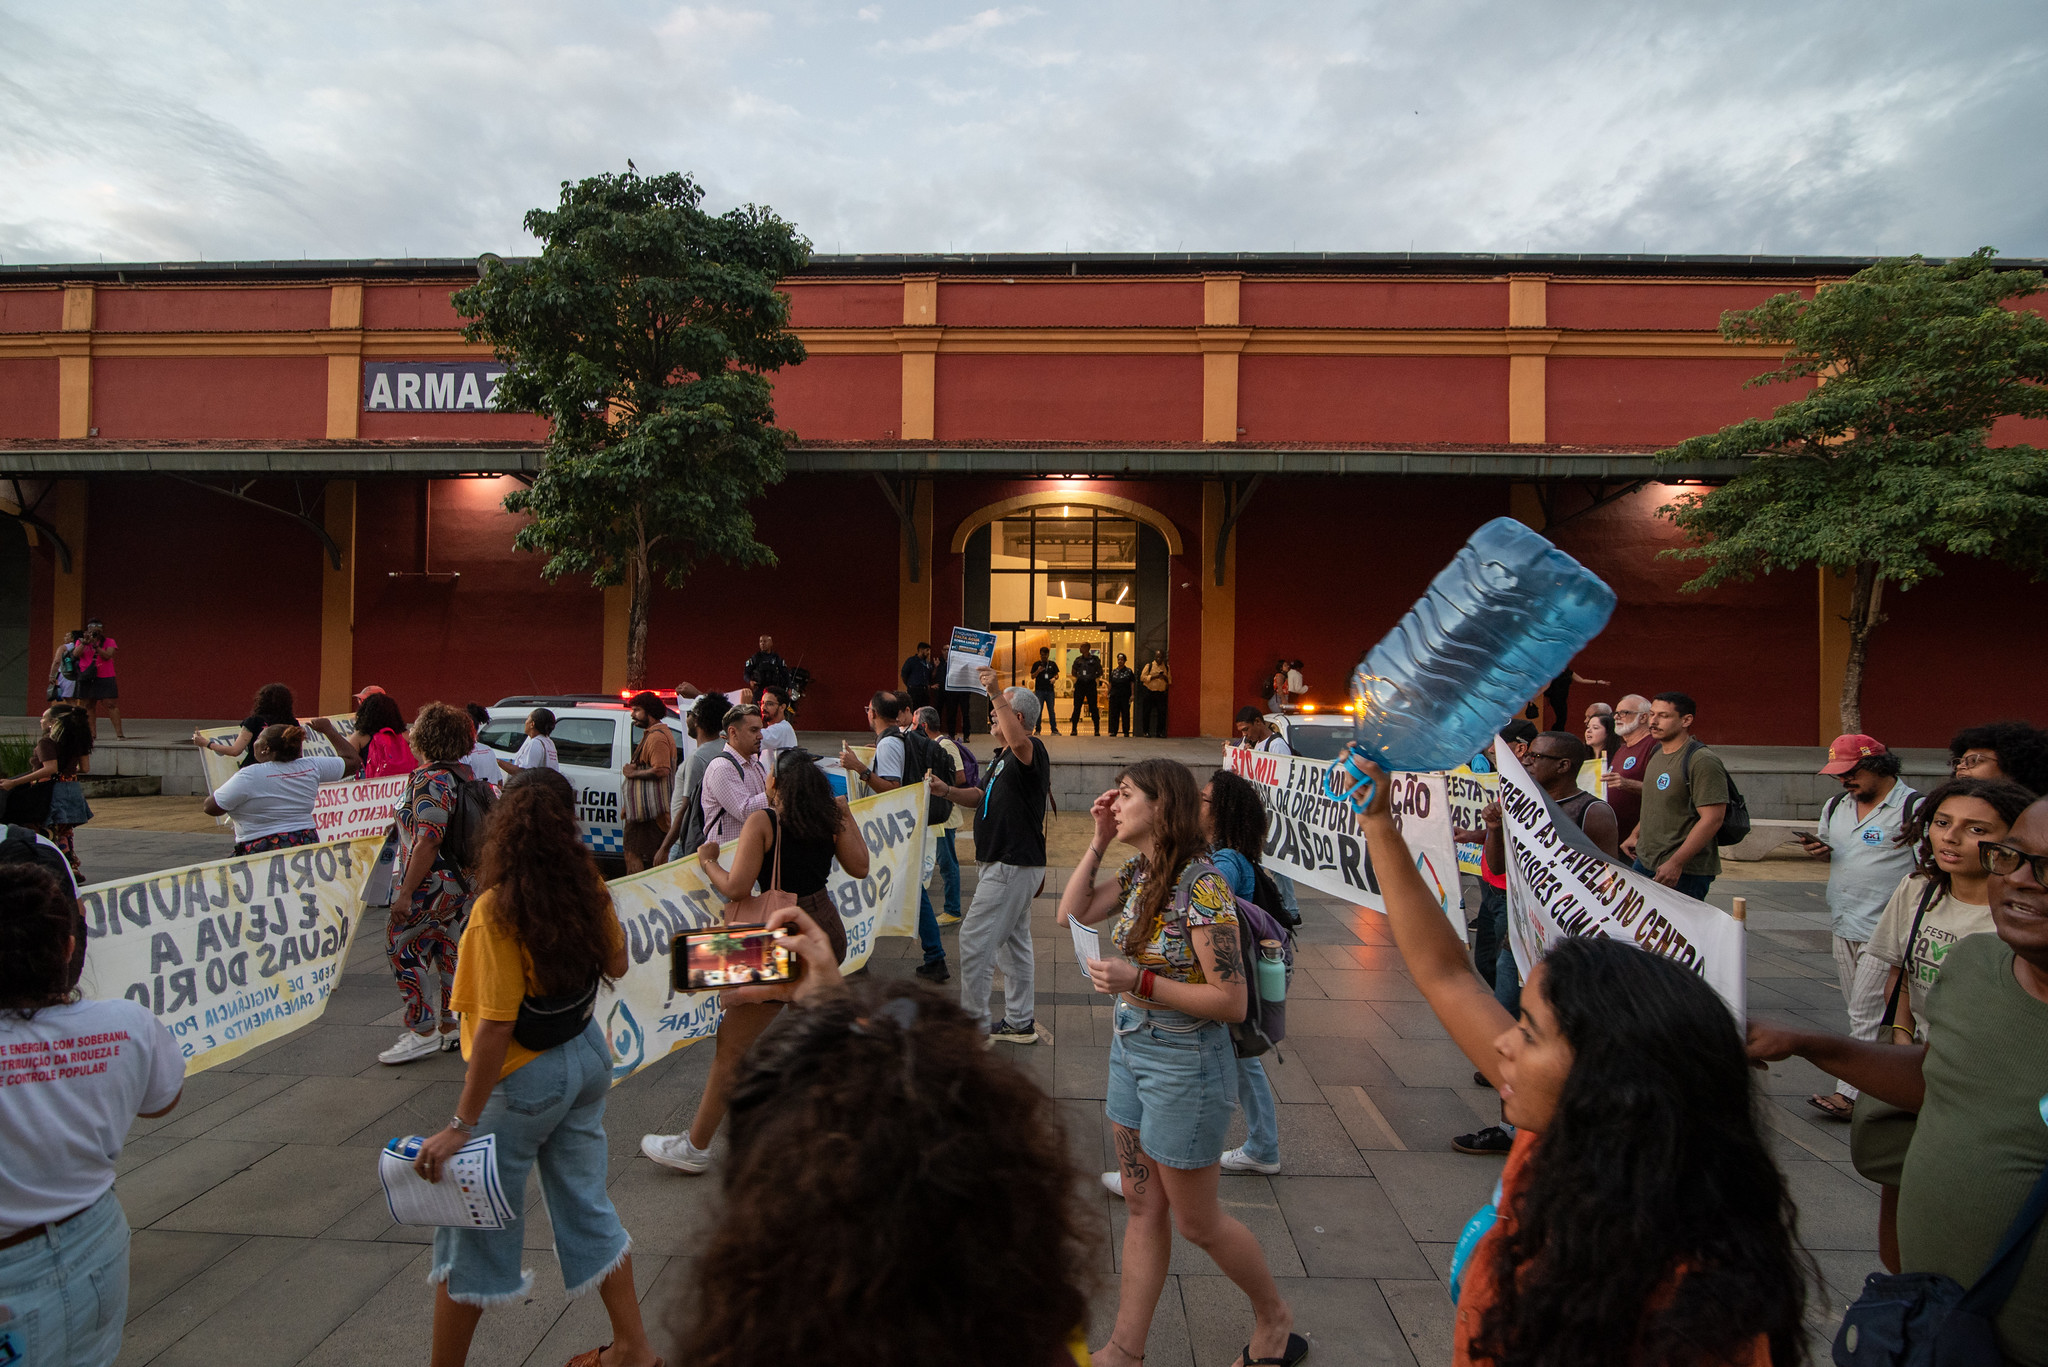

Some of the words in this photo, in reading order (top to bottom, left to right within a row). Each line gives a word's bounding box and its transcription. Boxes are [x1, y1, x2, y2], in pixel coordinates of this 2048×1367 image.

[368, 372, 509, 410] ARMAZ
[1255, 757, 1279, 786] MIL
[1287, 759, 1296, 789] É
[1297, 764, 1306, 791] A
[574, 787, 617, 807] LÍCIA
[579, 808, 617, 823] ITAR
[1262, 811, 1315, 870] UAS
[1313, 832, 1334, 864] DO
[1612, 886, 1645, 928] NO
[9, 1041, 50, 1055] ENERGIA
[53, 1038, 75, 1050] COM
[77, 1030, 131, 1048] SOBERANIA,
[0, 1055, 51, 1071] TRIBUIÇÃO
[54, 1054, 68, 1065] DA
[70, 1047, 112, 1063] RIQUEZA
[114, 1045, 120, 1056] E
[7, 1069, 56, 1086] CONTROLE
[59, 1062, 108, 1079] POPULAR!
